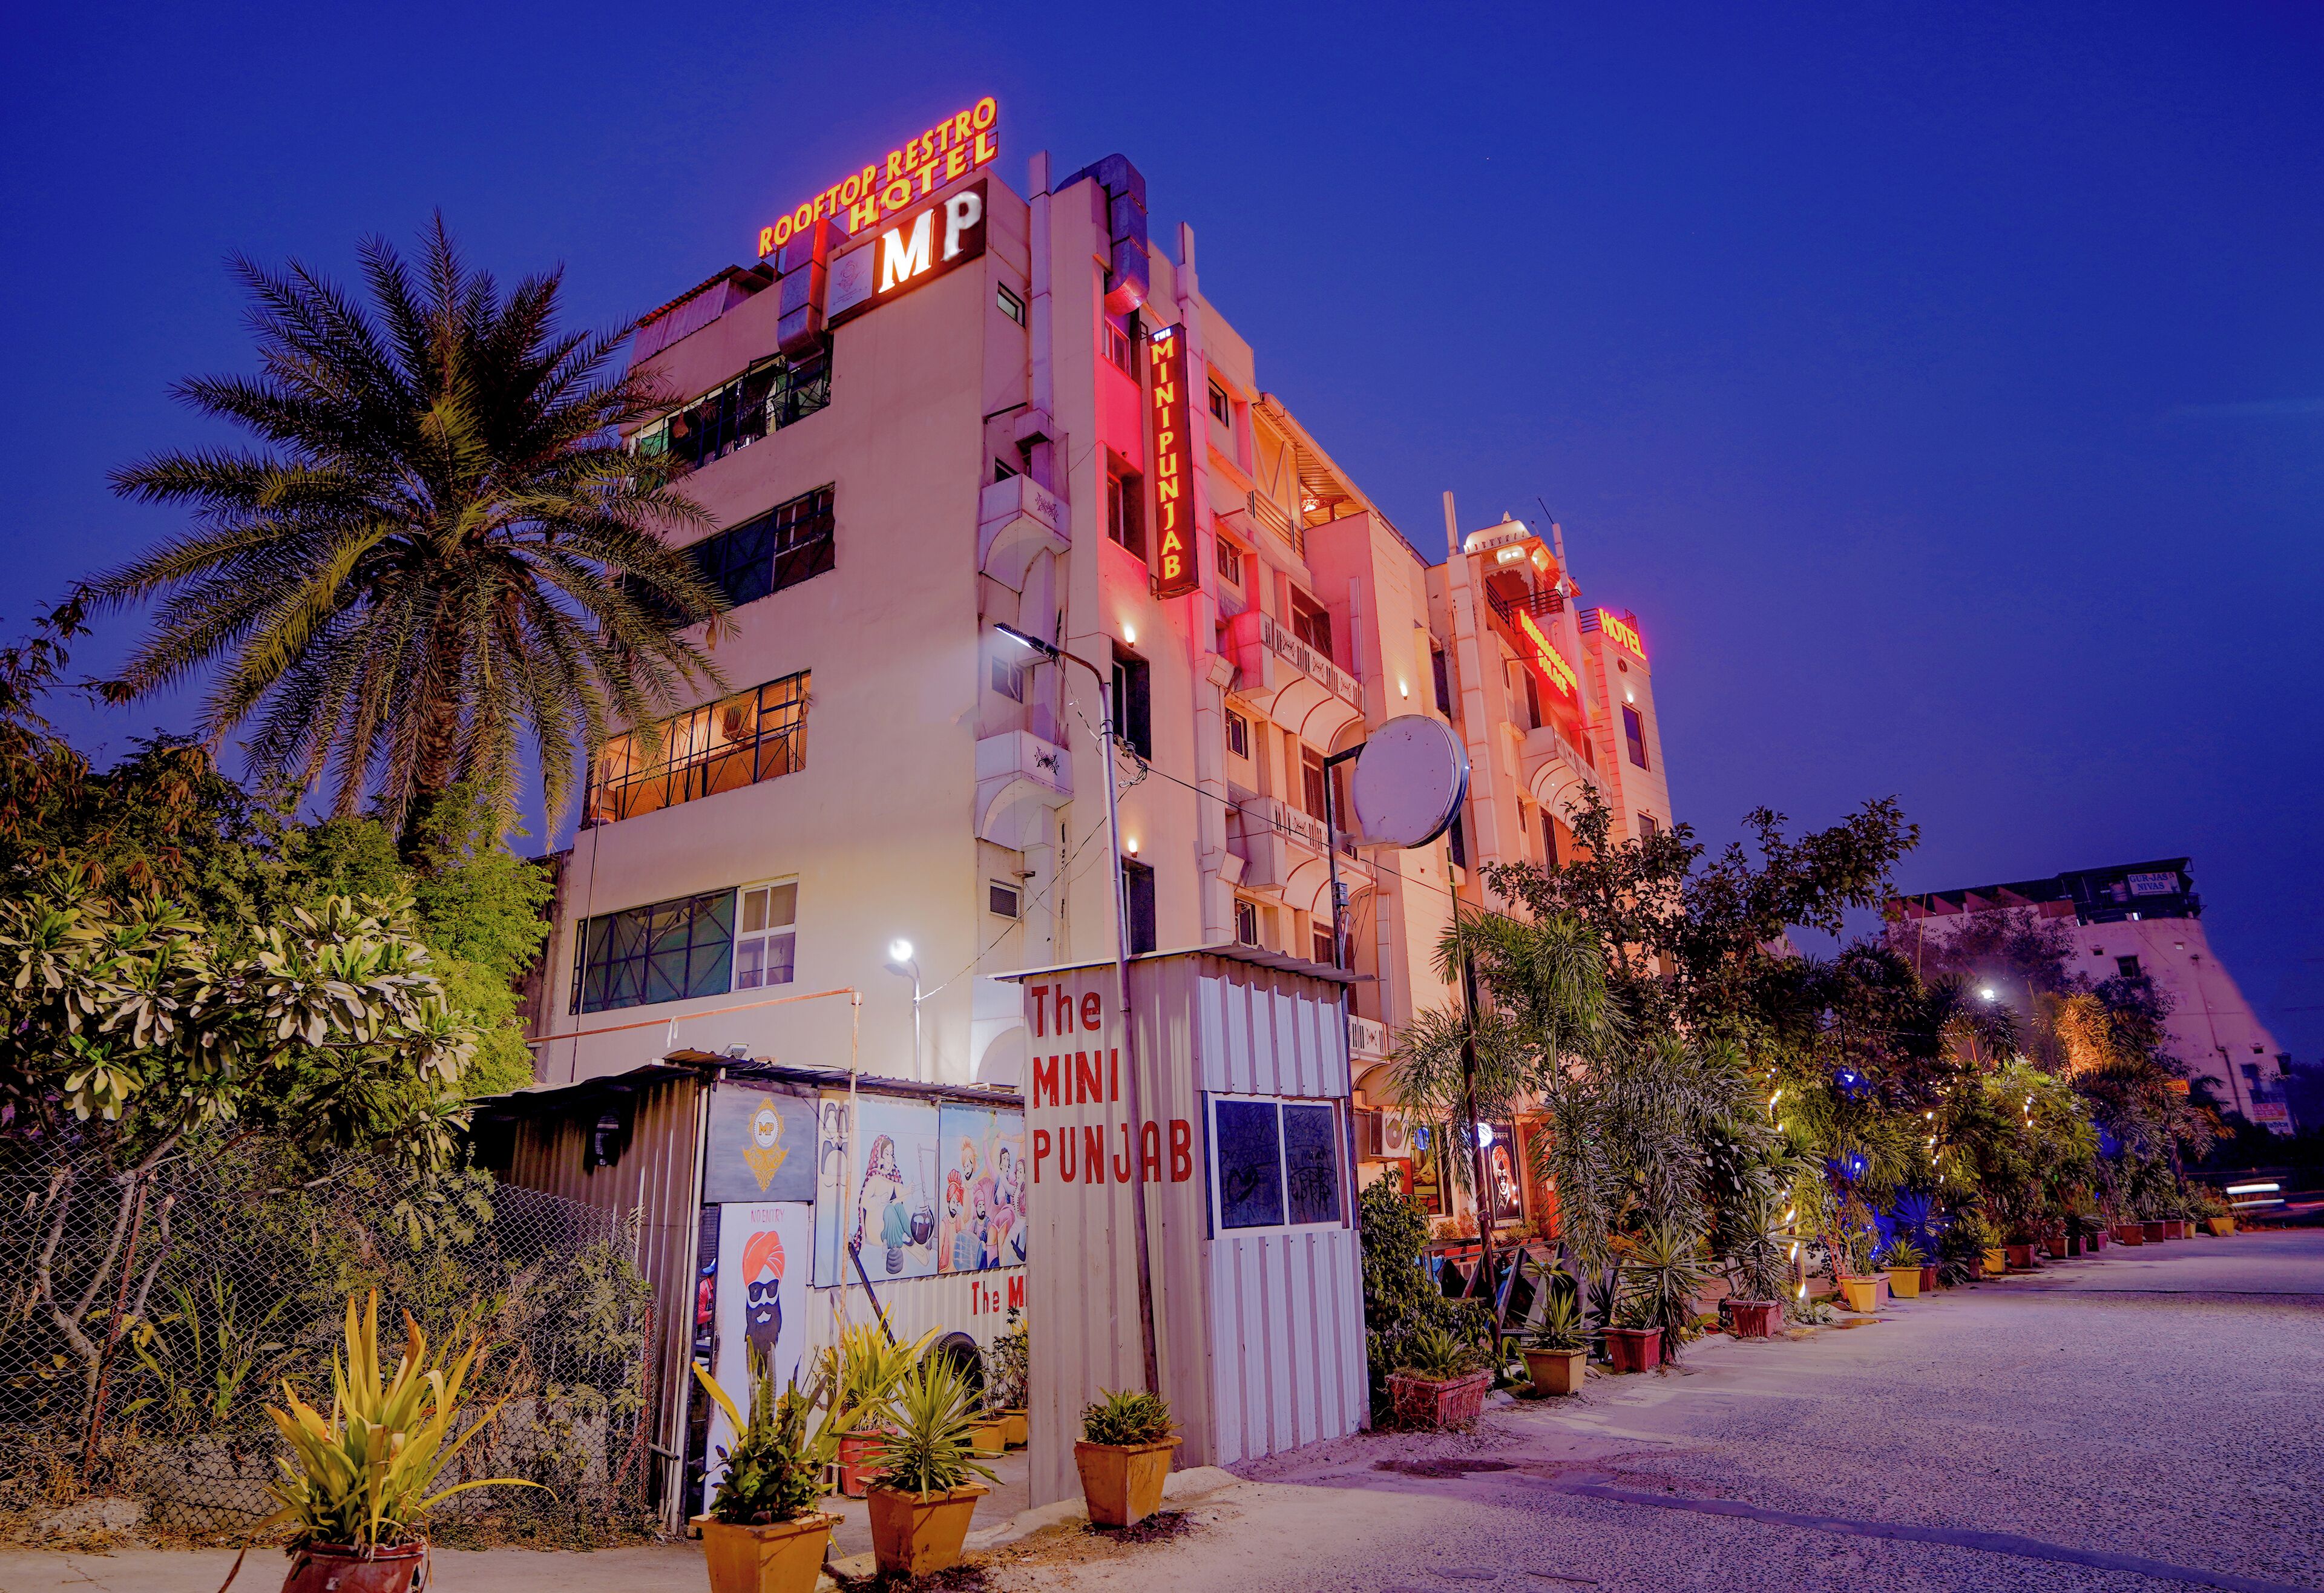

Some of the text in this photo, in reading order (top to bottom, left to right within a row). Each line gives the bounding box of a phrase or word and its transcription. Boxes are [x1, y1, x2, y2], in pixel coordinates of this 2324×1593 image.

[758, 97, 997, 258] ROOFTOP RESTRO
[849, 133, 997, 234] HOTEL
[878, 191, 983, 294] MP
[1598, 608, 1646, 660] HOTEL
[2129, 873, 2168, 882] GUR-JAS
[2137, 882, 2165, 891] NIVAS
[1031, 984, 1101, 1037] The
[1032, 1048, 1118, 1109] MINI
[758, 1122, 775, 1135] MP
[1034, 1119, 1192, 1184] PUNJAB
[972, 1281, 999, 1315] The
